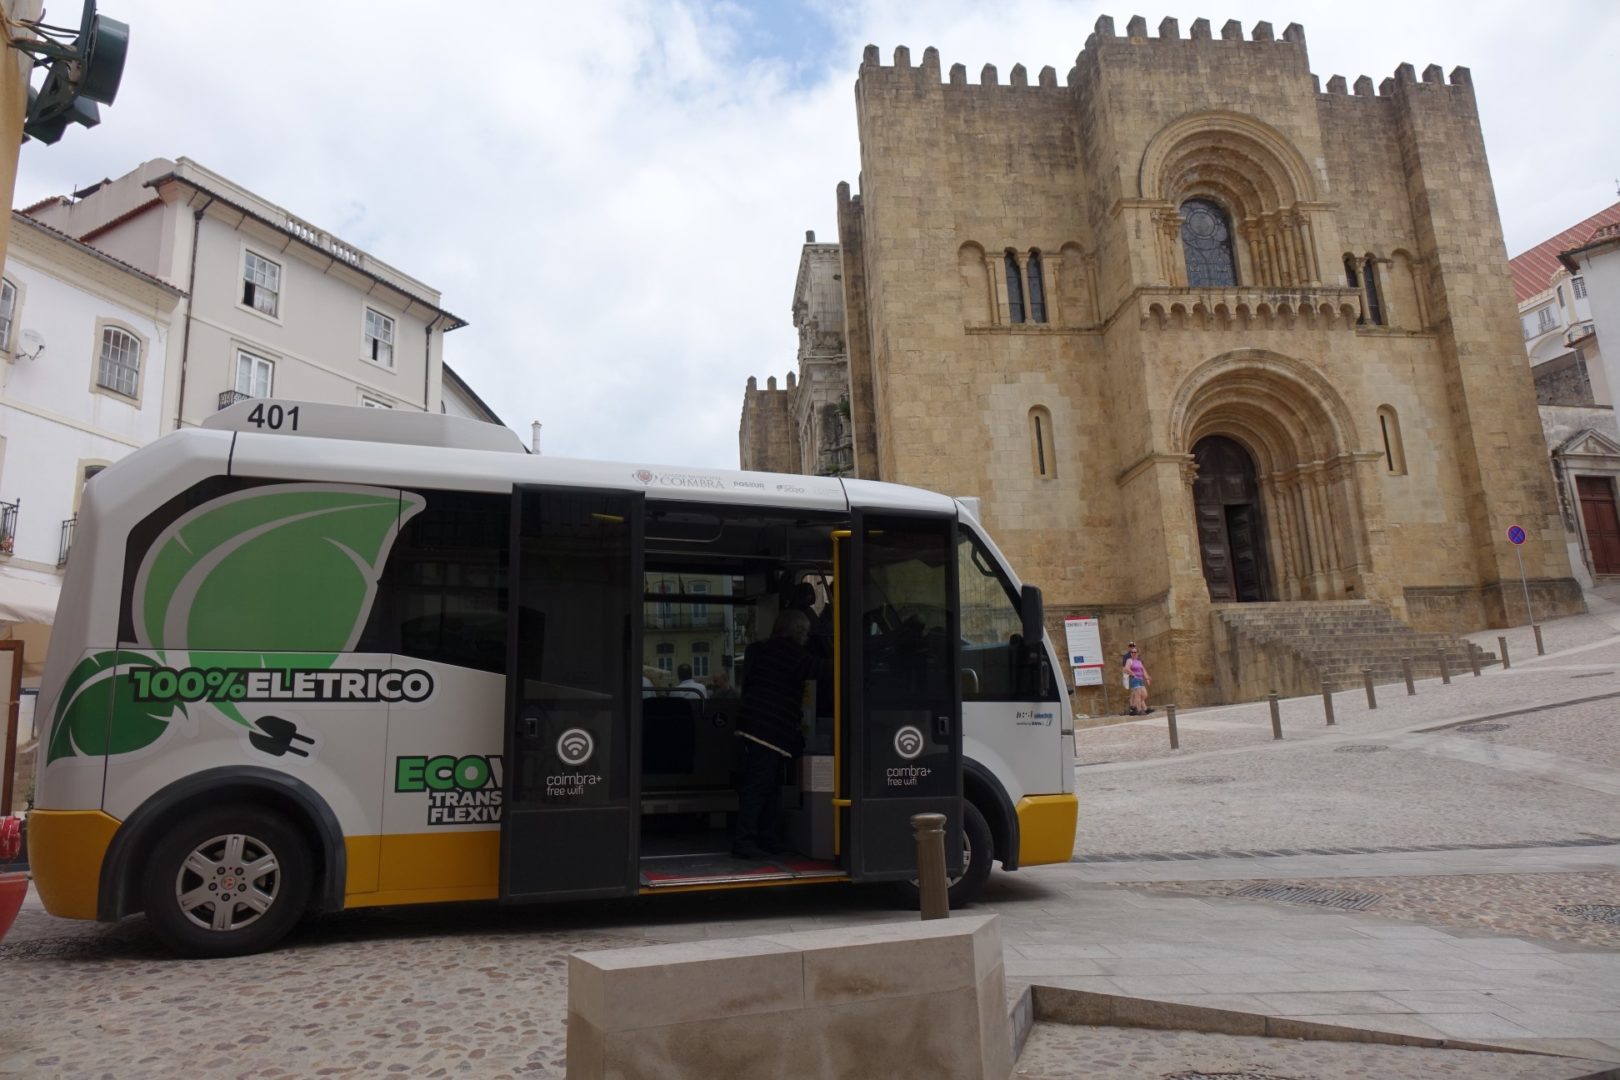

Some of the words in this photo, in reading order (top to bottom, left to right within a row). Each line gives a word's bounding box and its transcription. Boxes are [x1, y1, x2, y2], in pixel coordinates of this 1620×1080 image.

[247, 403, 299, 431] 401
[660, 476, 725, 489] COIMBRA
[886, 764, 932, 777] coimbra+
[546, 771, 603, 786] coimbra+
[887, 776, 902, 786] free
[547, 785, 566, 796] free
[567, 785, 584, 796] wifi
